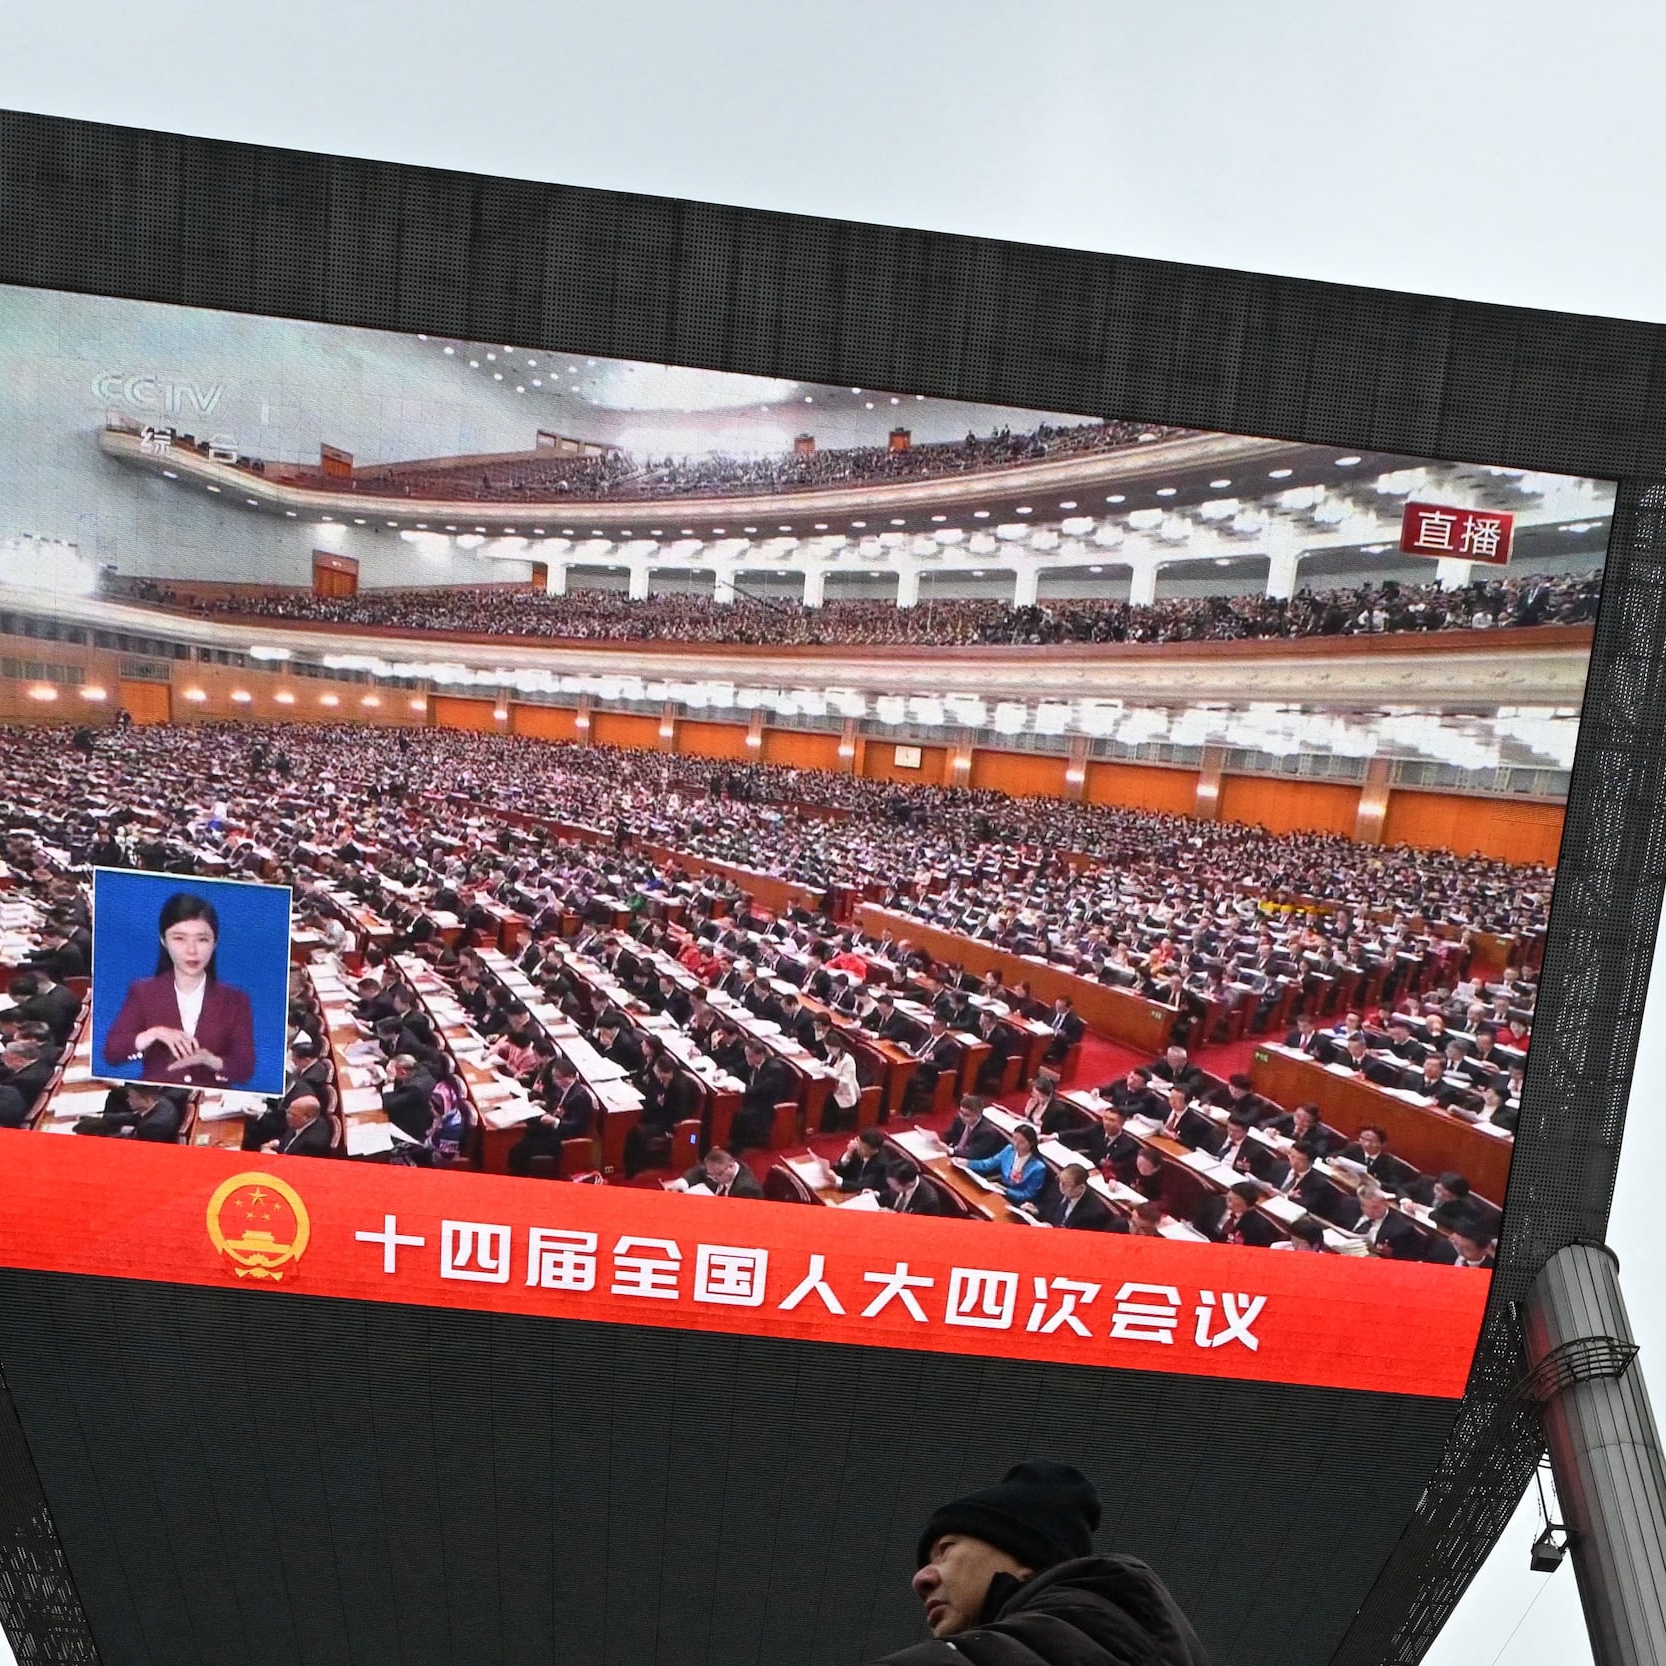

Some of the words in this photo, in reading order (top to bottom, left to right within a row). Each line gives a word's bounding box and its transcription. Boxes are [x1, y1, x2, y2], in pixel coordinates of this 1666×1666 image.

[90, 370, 228, 419] CCTV
[1413, 510, 1501, 557] 直播
[354, 1214, 1268, 1352] 十四届全国人大四次会议
